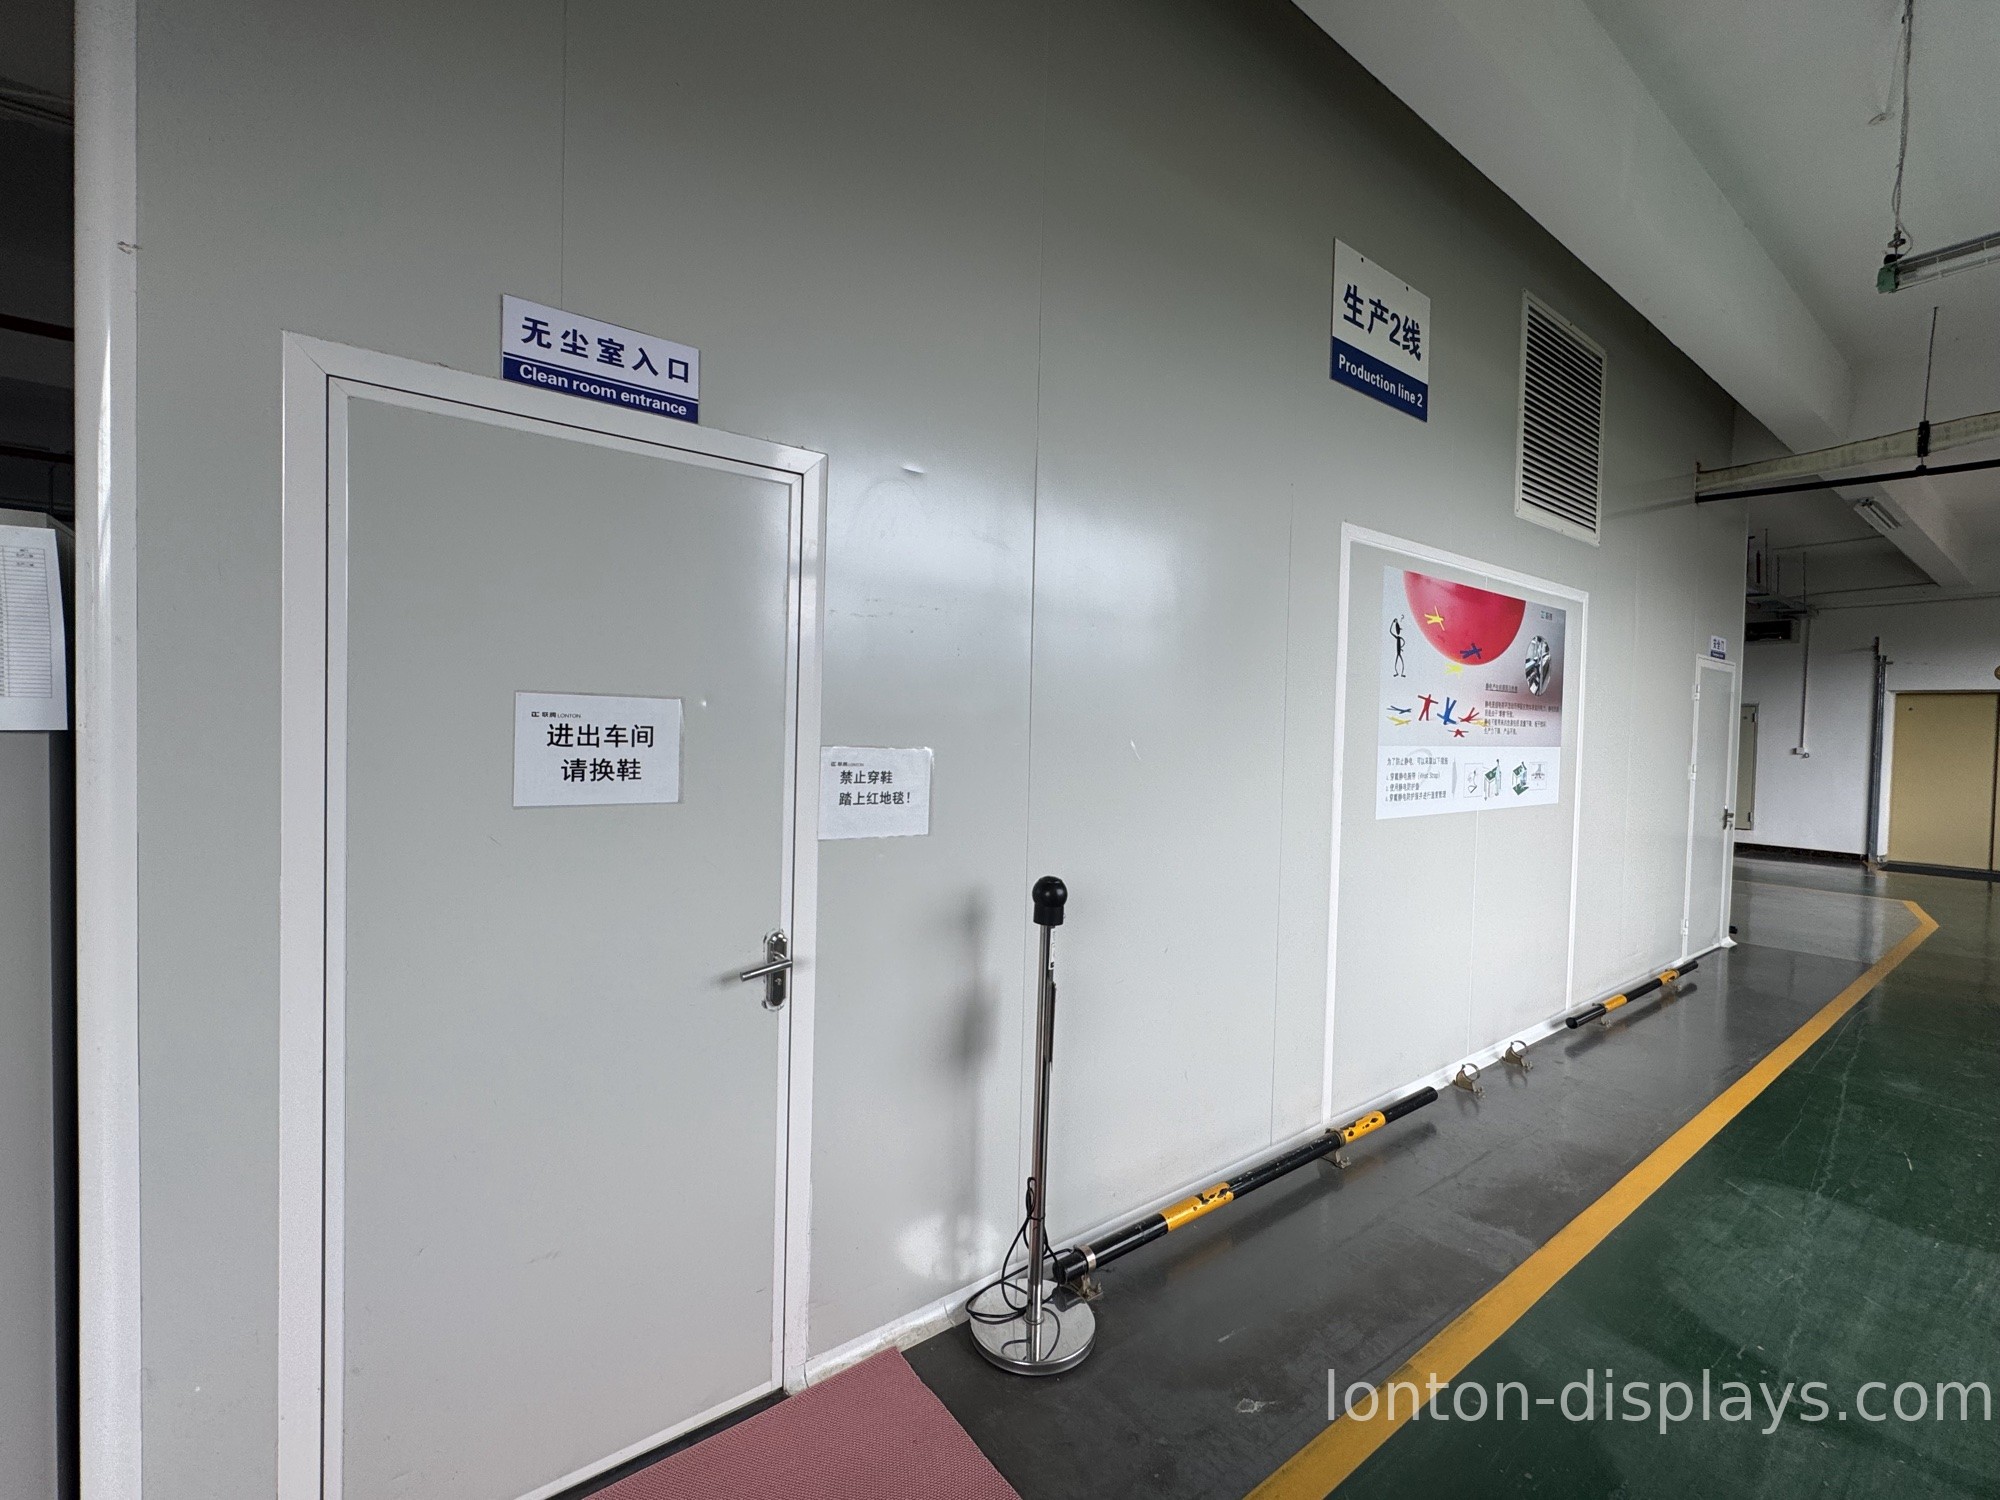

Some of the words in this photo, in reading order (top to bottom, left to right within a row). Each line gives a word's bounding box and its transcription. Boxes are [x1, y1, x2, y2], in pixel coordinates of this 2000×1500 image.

[1343, 283, 1422, 361] 生产2线
[521, 316, 689, 383] 无尘室入口
[519, 364, 569, 388] Clean
[573, 378, 617, 400] room
[620, 390, 687, 416] entrance
[1338, 353, 1396, 396] Production
[1398, 382, 1415, 404] line
[1417, 393, 1423, 408] 2
[546, 723, 654, 748] 进出车间
[561, 758, 642, 782] 请换鞋
[840, 770, 893, 784] 禁止穿鞋
[839, 791, 911, 806] 踏上红地毯！
